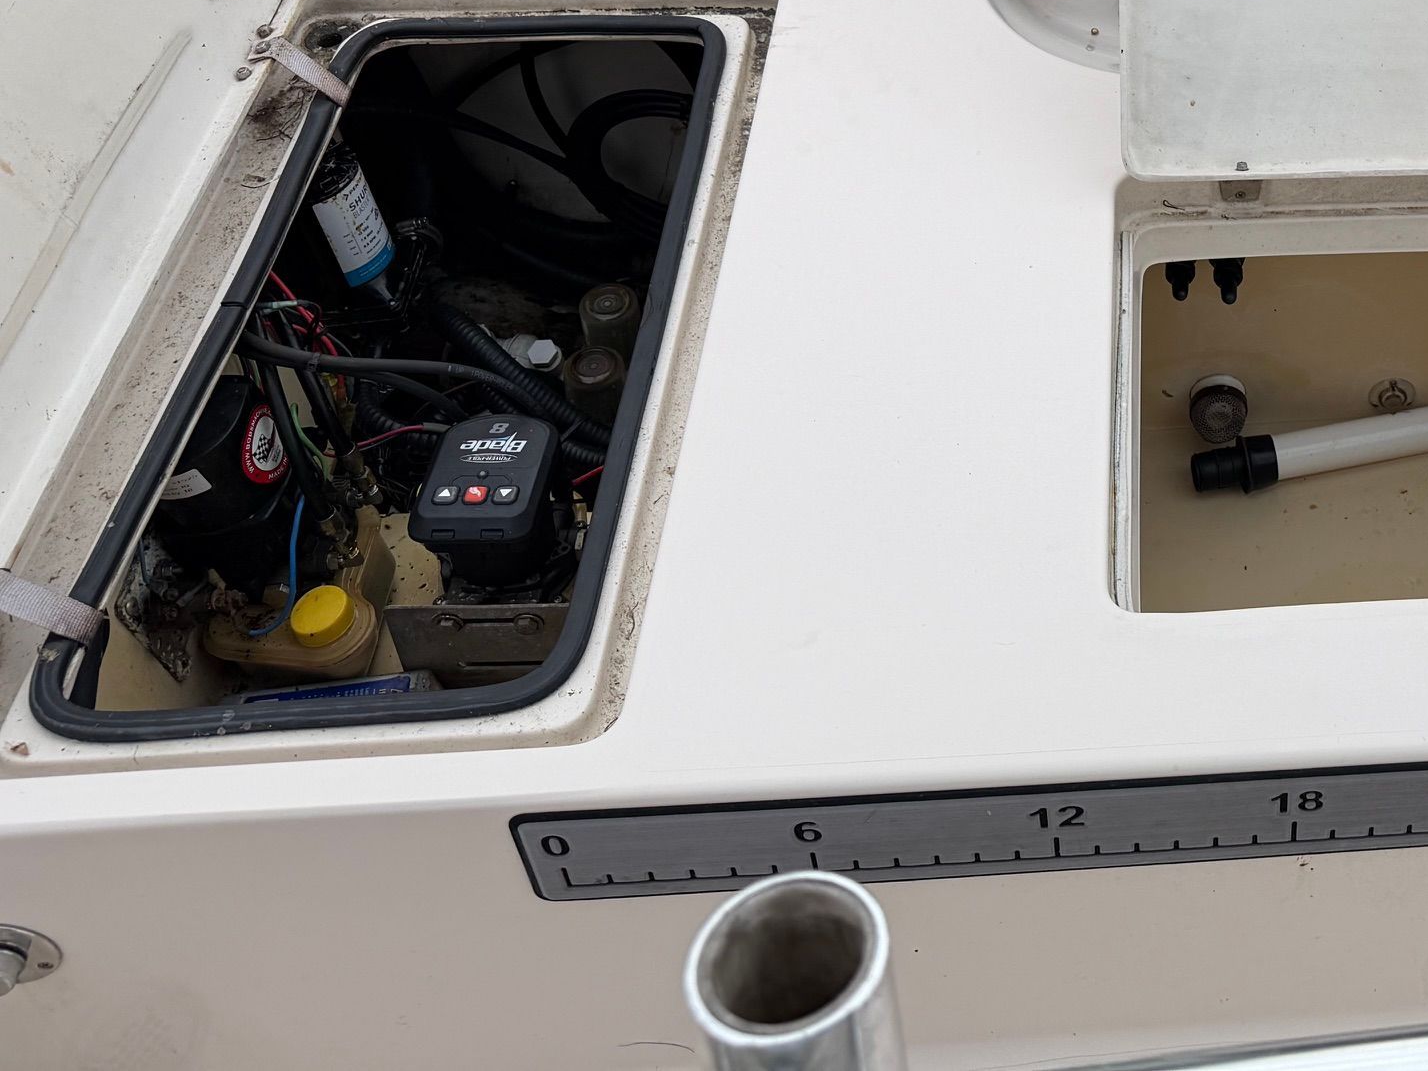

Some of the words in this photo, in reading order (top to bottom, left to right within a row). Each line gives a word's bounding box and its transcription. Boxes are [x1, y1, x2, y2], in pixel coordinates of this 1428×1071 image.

[489, 422, 510, 434] 8
[459, 431, 528, 453] Blade
[540, 834, 571, 857] 0
[793, 821, 823, 843] 6
[1028, 805, 1086, 829] 12
[1271, 790, 1325, 814] 18
